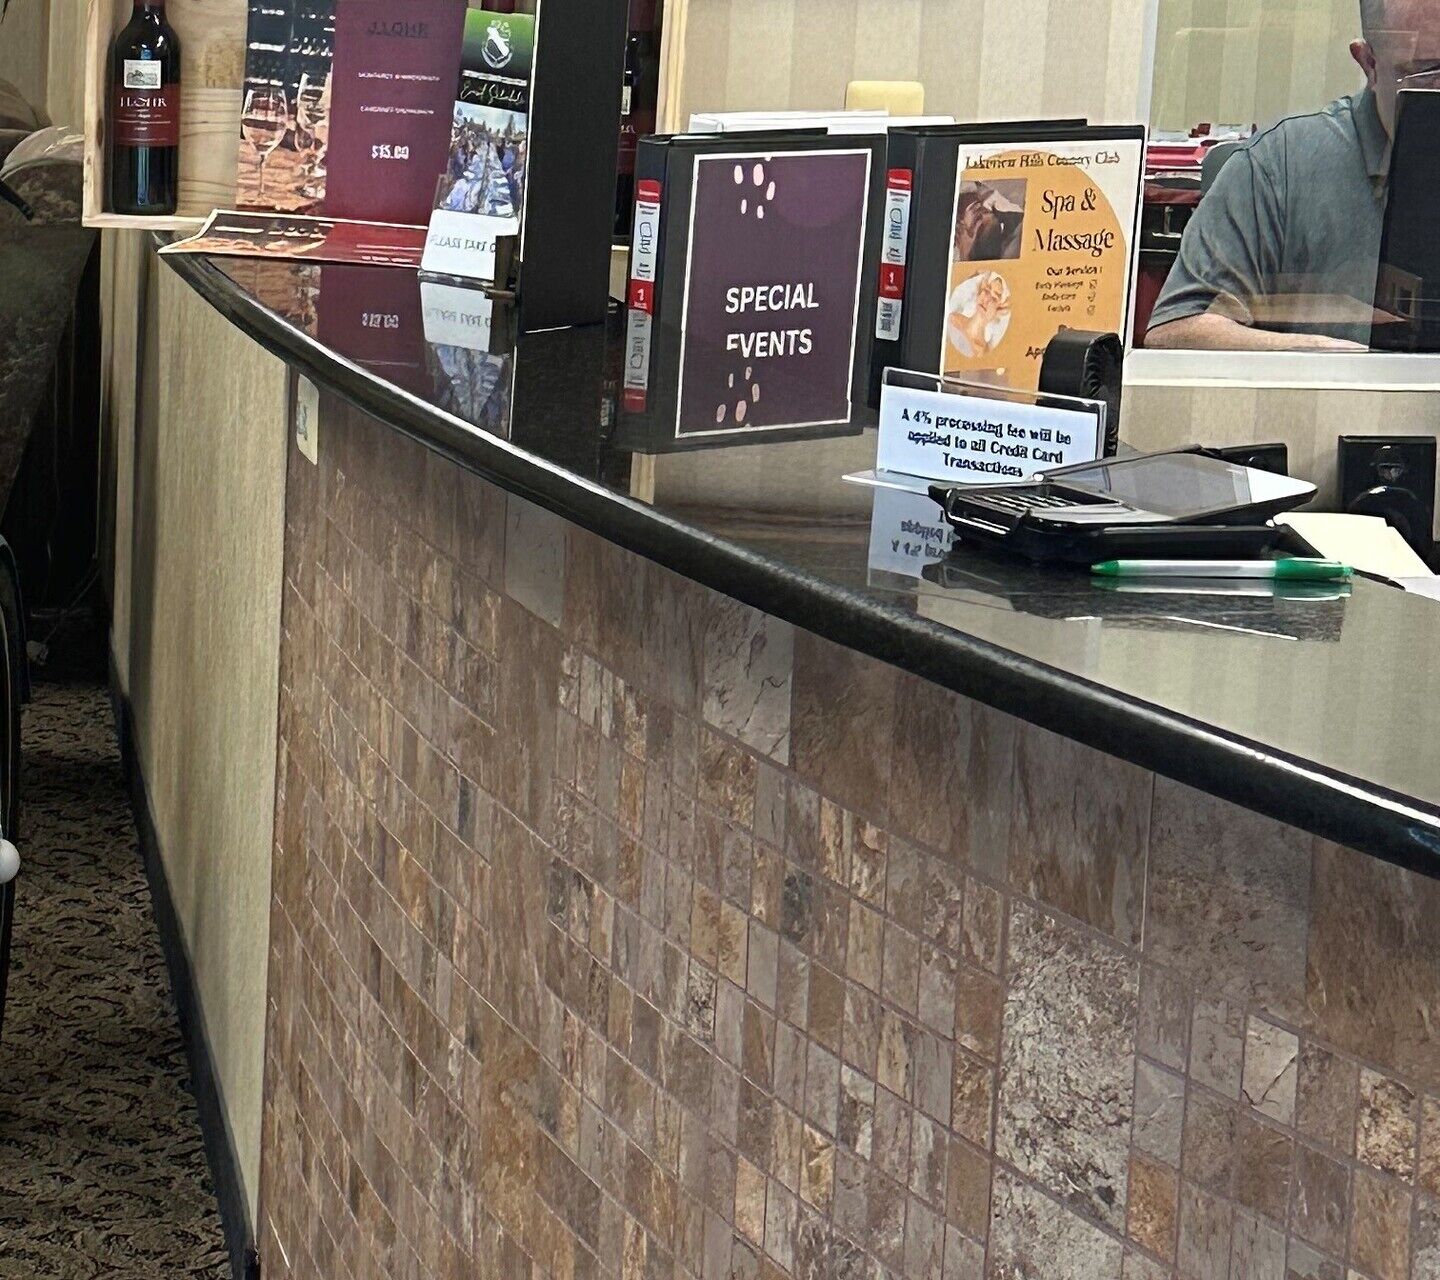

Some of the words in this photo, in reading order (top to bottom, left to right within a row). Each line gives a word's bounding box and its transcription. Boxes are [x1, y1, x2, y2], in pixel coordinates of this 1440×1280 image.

[1041, 189, 1075, 220] Spa
[1080, 187, 1097, 211] &
[1032, 228, 1115, 257] Massage
[725, 283, 819, 313] SPECIAL
[726, 329, 812, 358] EVENTS
[901, 408, 910, 421] A
[913, 410, 932, 424] 4%
[935, 415, 1003, 438] processing
[1007, 424, 1026, 438] fee
[1029, 428, 1052, 442] will
[1055, 430, 1071, 445] be
[907, 431, 951, 447] applied
[954, 436, 967, 449] to
[970, 439, 986, 452] all
[990, 441, 1028, 458] Credit
[1032, 447, 1063, 464] Card
[942, 452, 1023, 478] Transactions
